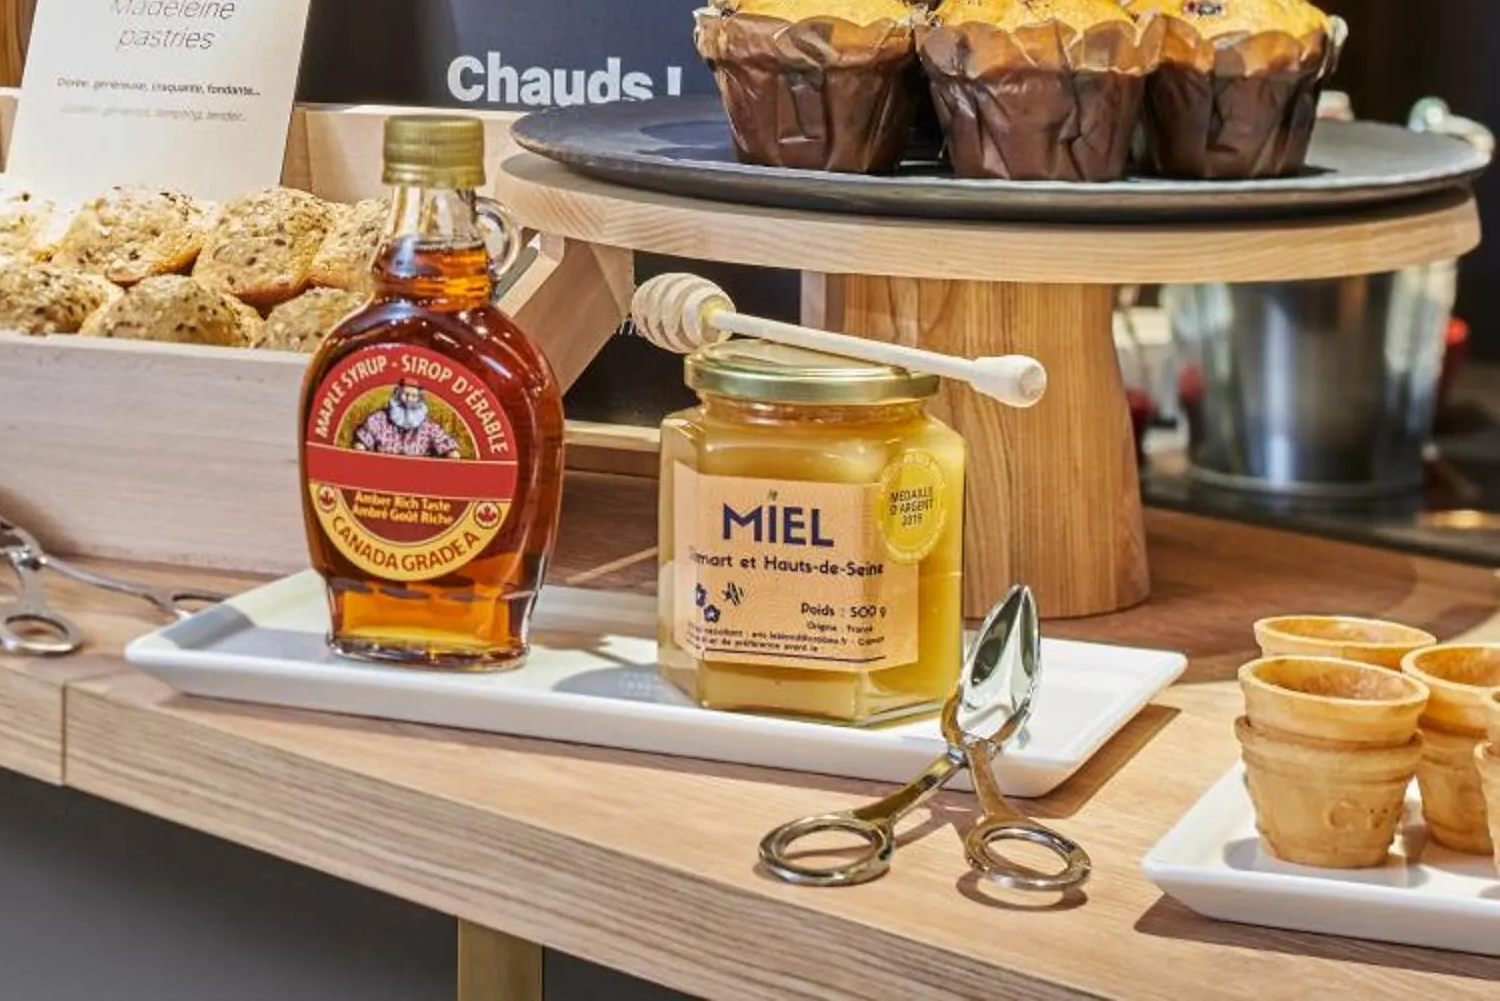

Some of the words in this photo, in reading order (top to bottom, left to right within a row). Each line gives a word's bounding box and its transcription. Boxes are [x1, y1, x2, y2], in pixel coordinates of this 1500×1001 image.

[116, 27, 216, 53] pastries
[447, 51, 654, 107] Chauds
[315, 381, 346, 439] MAPLE
[341, 355, 388, 389] SYRUP
[402, 354, 453, 383] SIROP
[451, 376, 509, 453] D'ÉRABLE
[332, 516, 399, 571] CANADA
[401, 543, 467, 572] GRADE
[466, 531, 481, 550] A
[722, 502, 835, 547] MIEL
[740, 557, 756, 569] et
[764, 555, 884, 576] Hauts-de-Seine
[801, 602, 835, 616] Poids
[850, 605, 877, 618] 500
